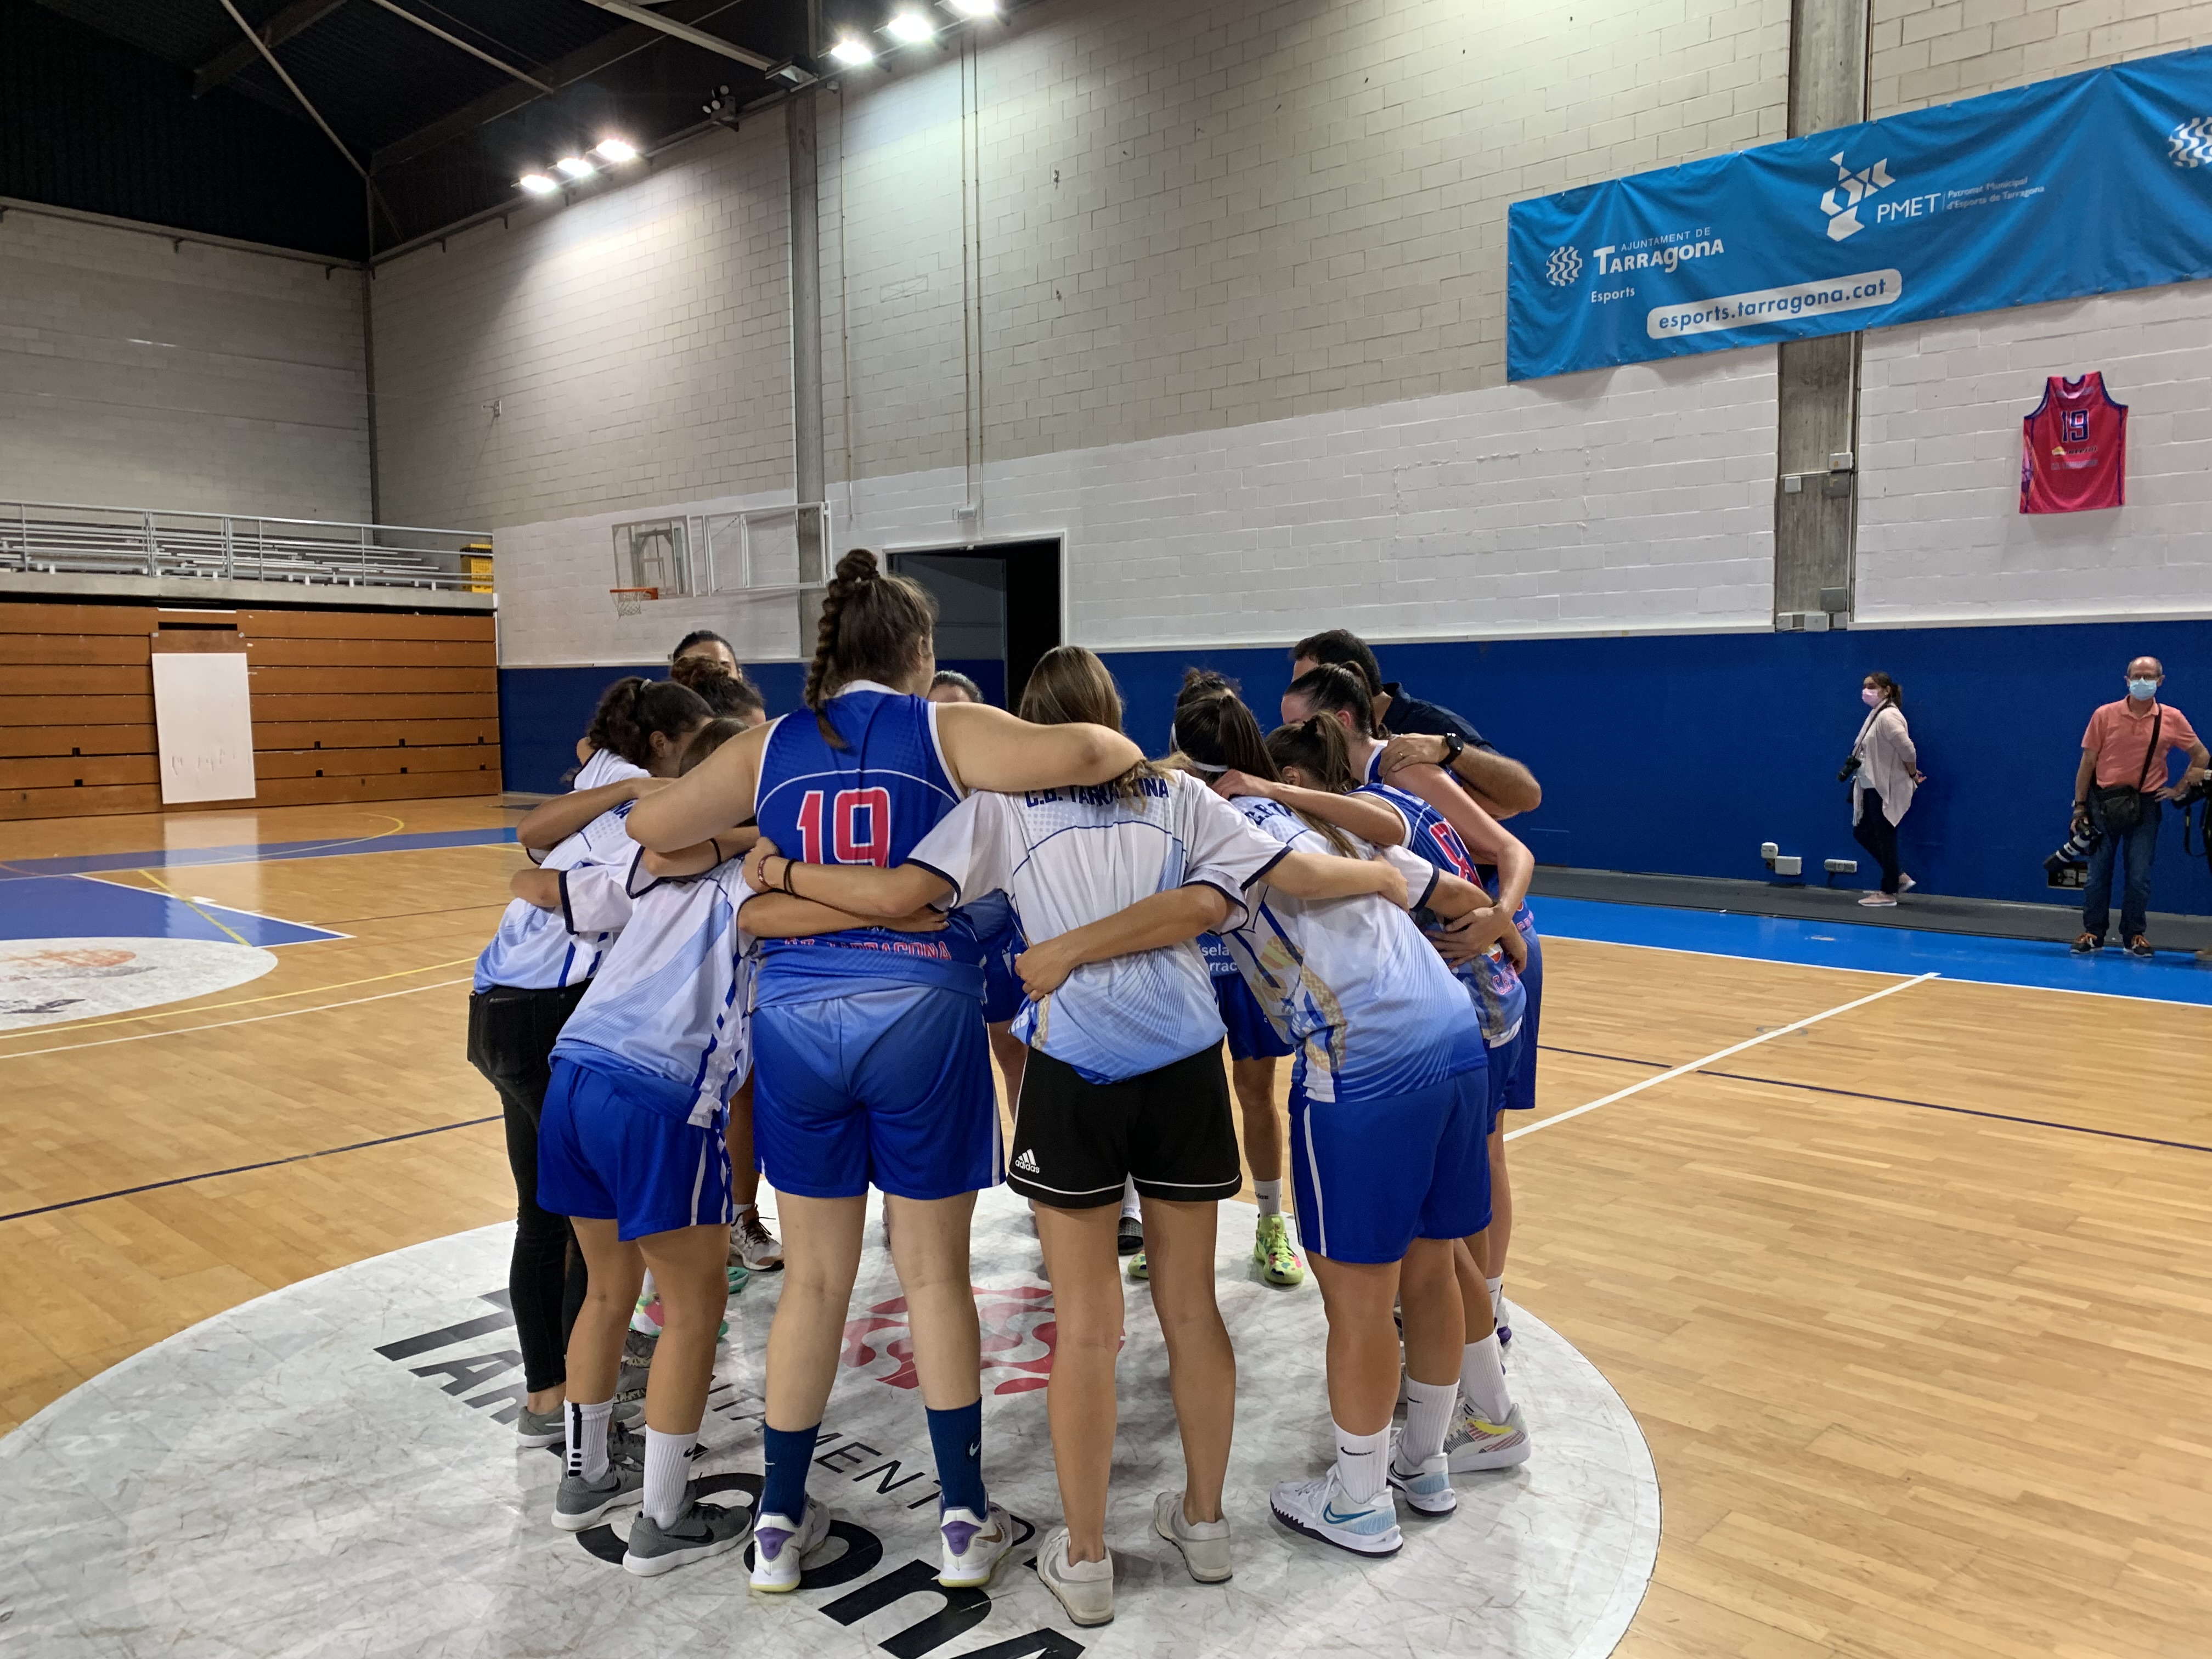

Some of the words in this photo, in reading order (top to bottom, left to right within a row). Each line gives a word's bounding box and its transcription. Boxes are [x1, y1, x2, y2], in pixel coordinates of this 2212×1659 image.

[1877, 192, 1942, 224] PMET
[1621, 230, 1691, 252] AJUNTAMENT
[1695, 227, 1711, 238] DE
[1591, 286, 1635, 304] Esports
[1658, 278, 1887, 331] esports.tarragona.cat
[2061, 409, 2090, 443] 19
[797, 786, 891, 868] 19
[1015, 1159, 1040, 1174] adidas
